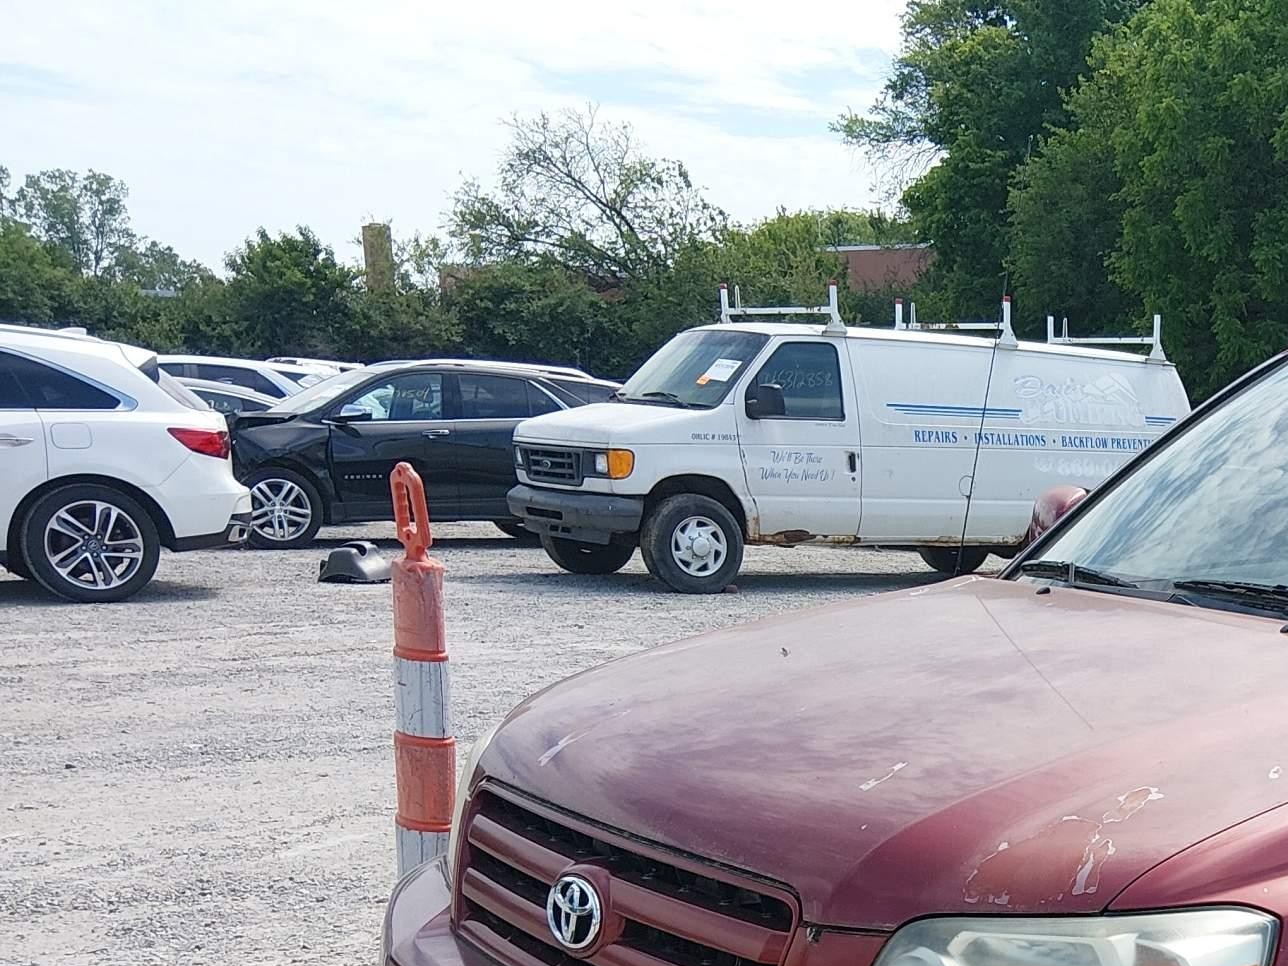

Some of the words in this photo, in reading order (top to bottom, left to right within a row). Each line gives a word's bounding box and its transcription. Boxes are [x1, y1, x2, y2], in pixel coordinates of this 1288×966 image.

[914, 430, 958, 443] REPAIRS
[974, 432, 1047, 446] INSTALLATIONS
[1061, 435, 1109, 449] BACKFLOW
